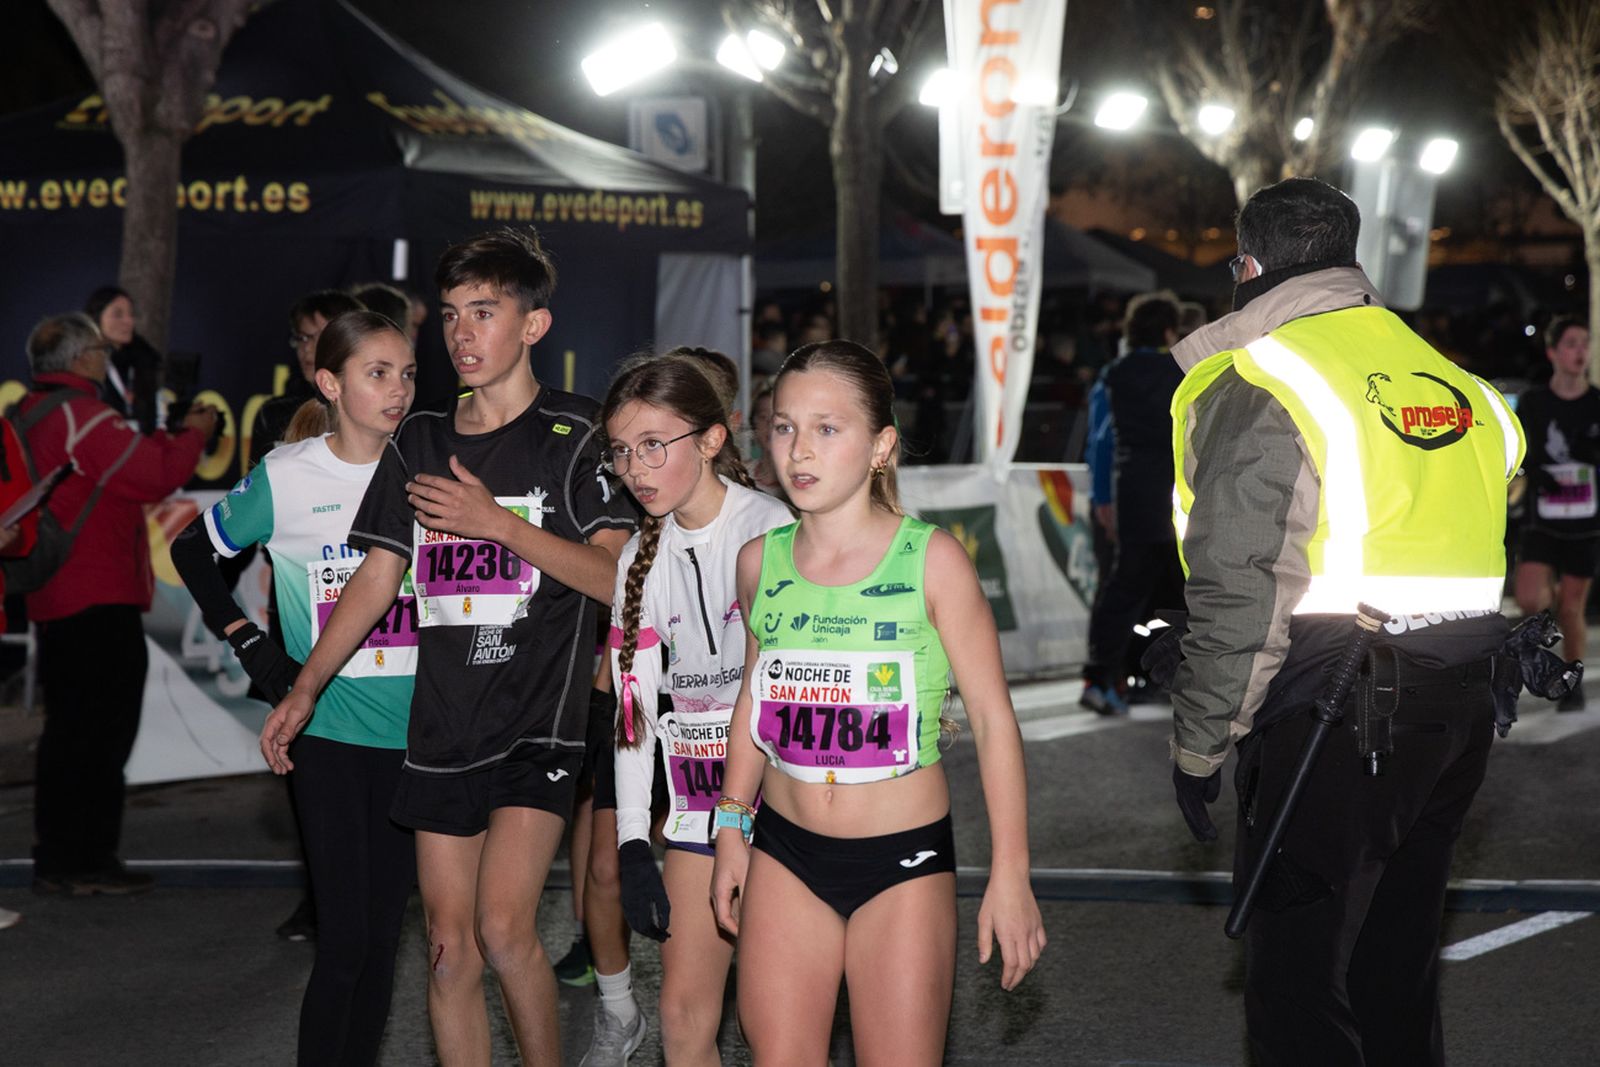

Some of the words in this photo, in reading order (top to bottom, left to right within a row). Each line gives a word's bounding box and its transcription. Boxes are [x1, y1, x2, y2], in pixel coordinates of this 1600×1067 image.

[470, 190, 704, 232] www.evedeport.es
[312, 503, 342, 514] FASTER
[426, 542, 522, 583] 14236
[324, 587, 341, 601] SA
[456, 583, 480, 593] Álvaro
[813, 612, 868, 625] Fundación
[812, 624, 851, 637] Unicaja
[476, 634, 502, 648] SAN
[473, 642, 517, 661] ANTÓN
[672, 672, 708, 691] SIERRA
[785, 666, 831, 683] NOCHE
[833, 669, 852, 684] DE
[769, 684, 796, 701] SAN
[800, 683, 852, 704] ANTÓN
[680, 726, 713, 740] NOCHE
[775, 704, 892, 752] 14784
[674, 741, 693, 756] SAN
[815, 754, 845, 766] LUCIA
